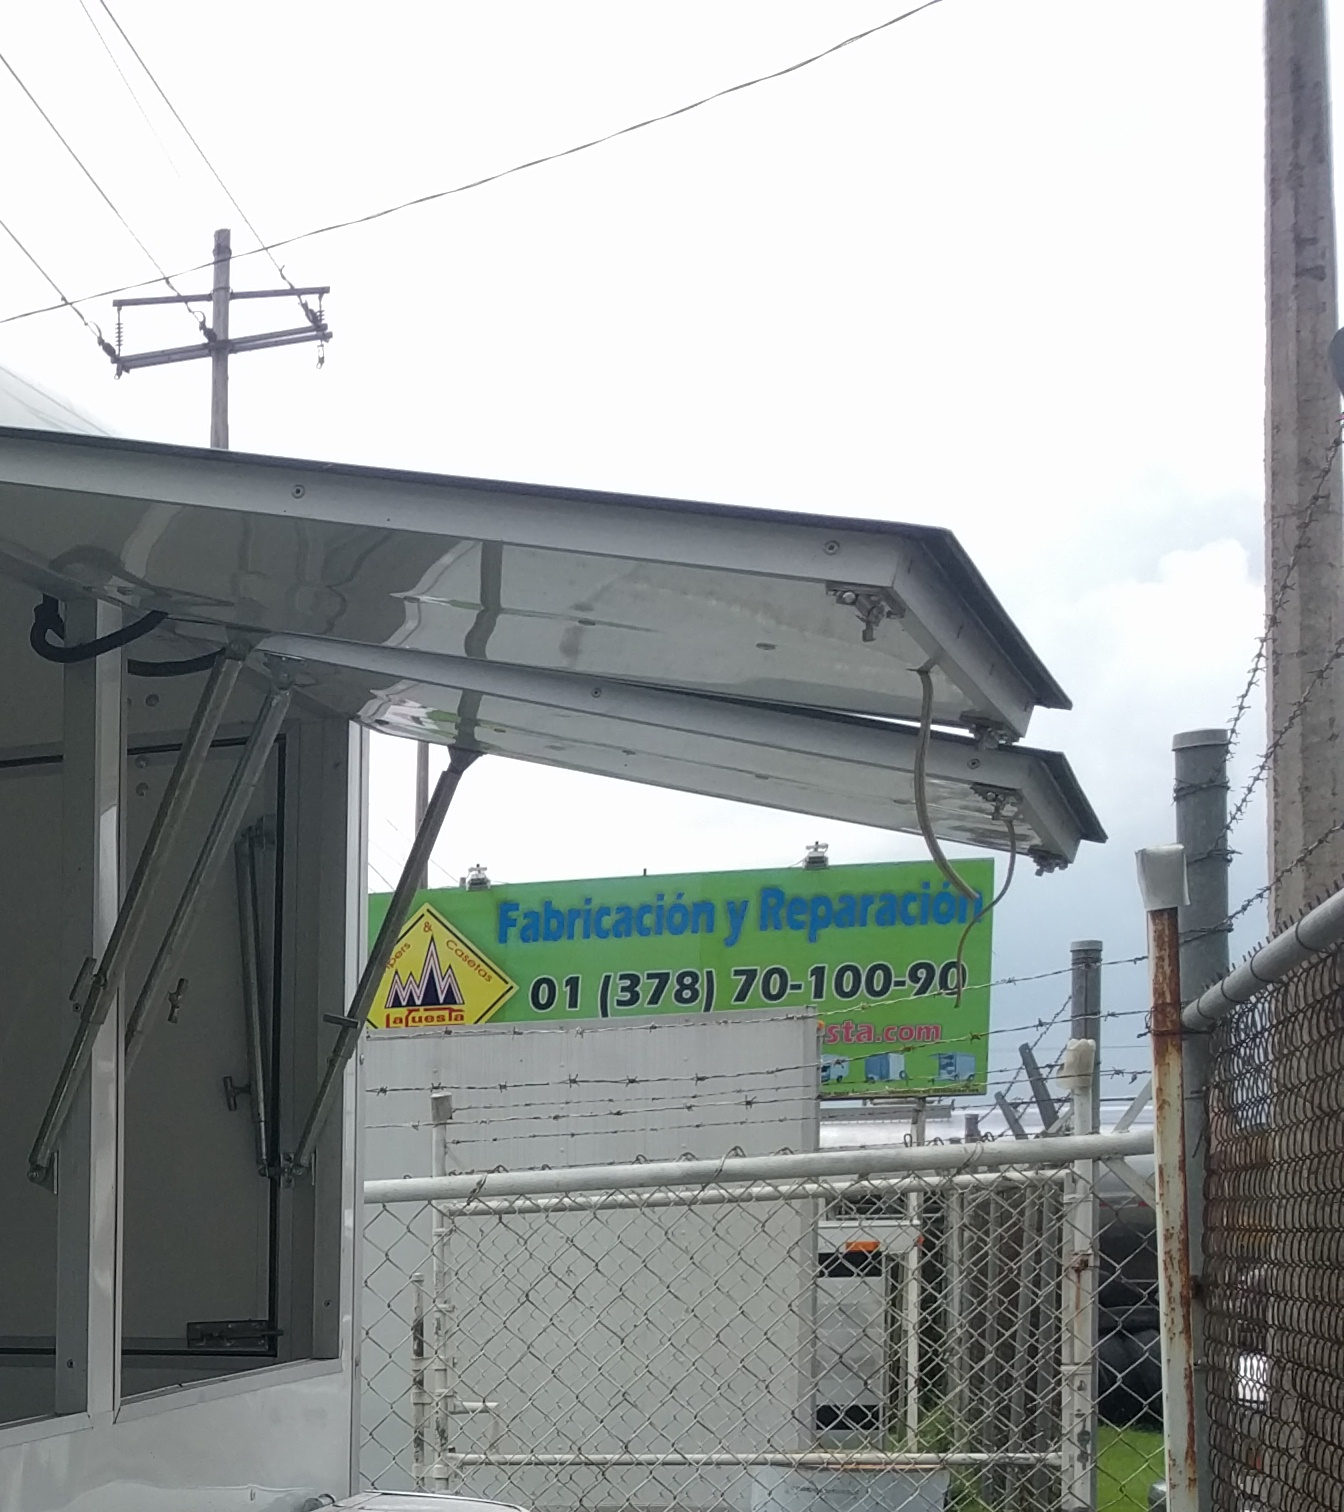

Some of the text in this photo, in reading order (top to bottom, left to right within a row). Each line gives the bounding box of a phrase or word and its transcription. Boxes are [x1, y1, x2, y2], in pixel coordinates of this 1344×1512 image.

[497, 880, 985, 947] Fabricación y Reparación
[386, 921, 493, 983] pers & Casetas
[529, 959, 968, 1018] 01 (378) 70-100-90
[825, 1020, 942, 1044] sta.com
